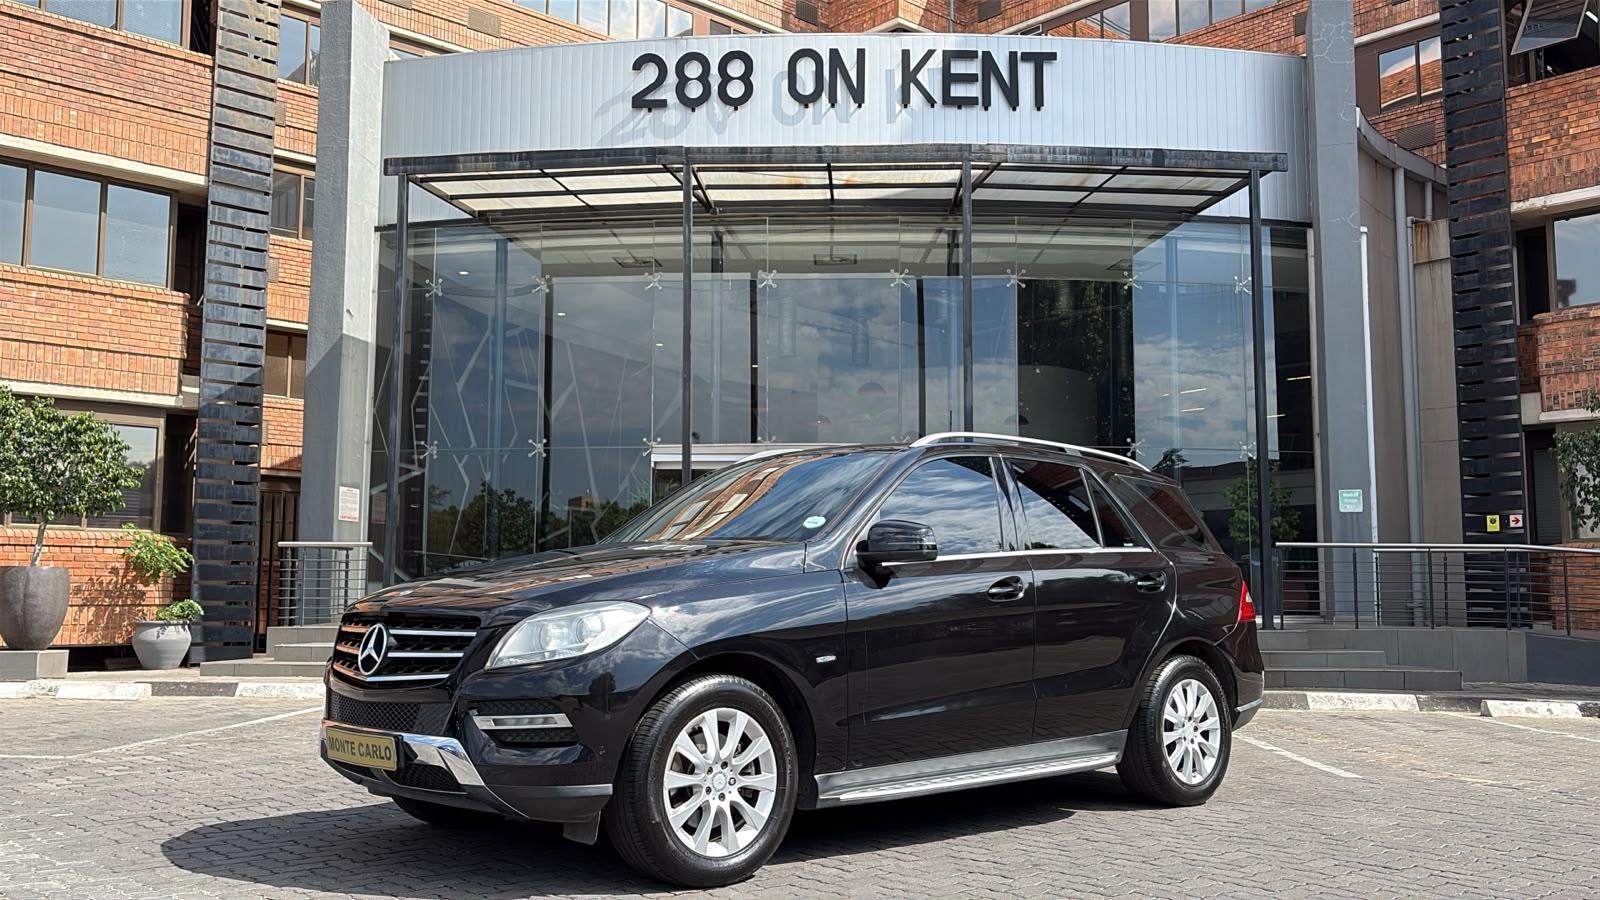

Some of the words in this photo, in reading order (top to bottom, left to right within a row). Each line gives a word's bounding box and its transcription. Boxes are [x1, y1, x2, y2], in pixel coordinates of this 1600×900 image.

[631, 50, 754, 109] 288
[787, 48, 866, 106] ON
[901, 48, 1058, 109] KENT
[328, 736, 356, 756] MONTE
[358, 742, 392, 761] CARLO
